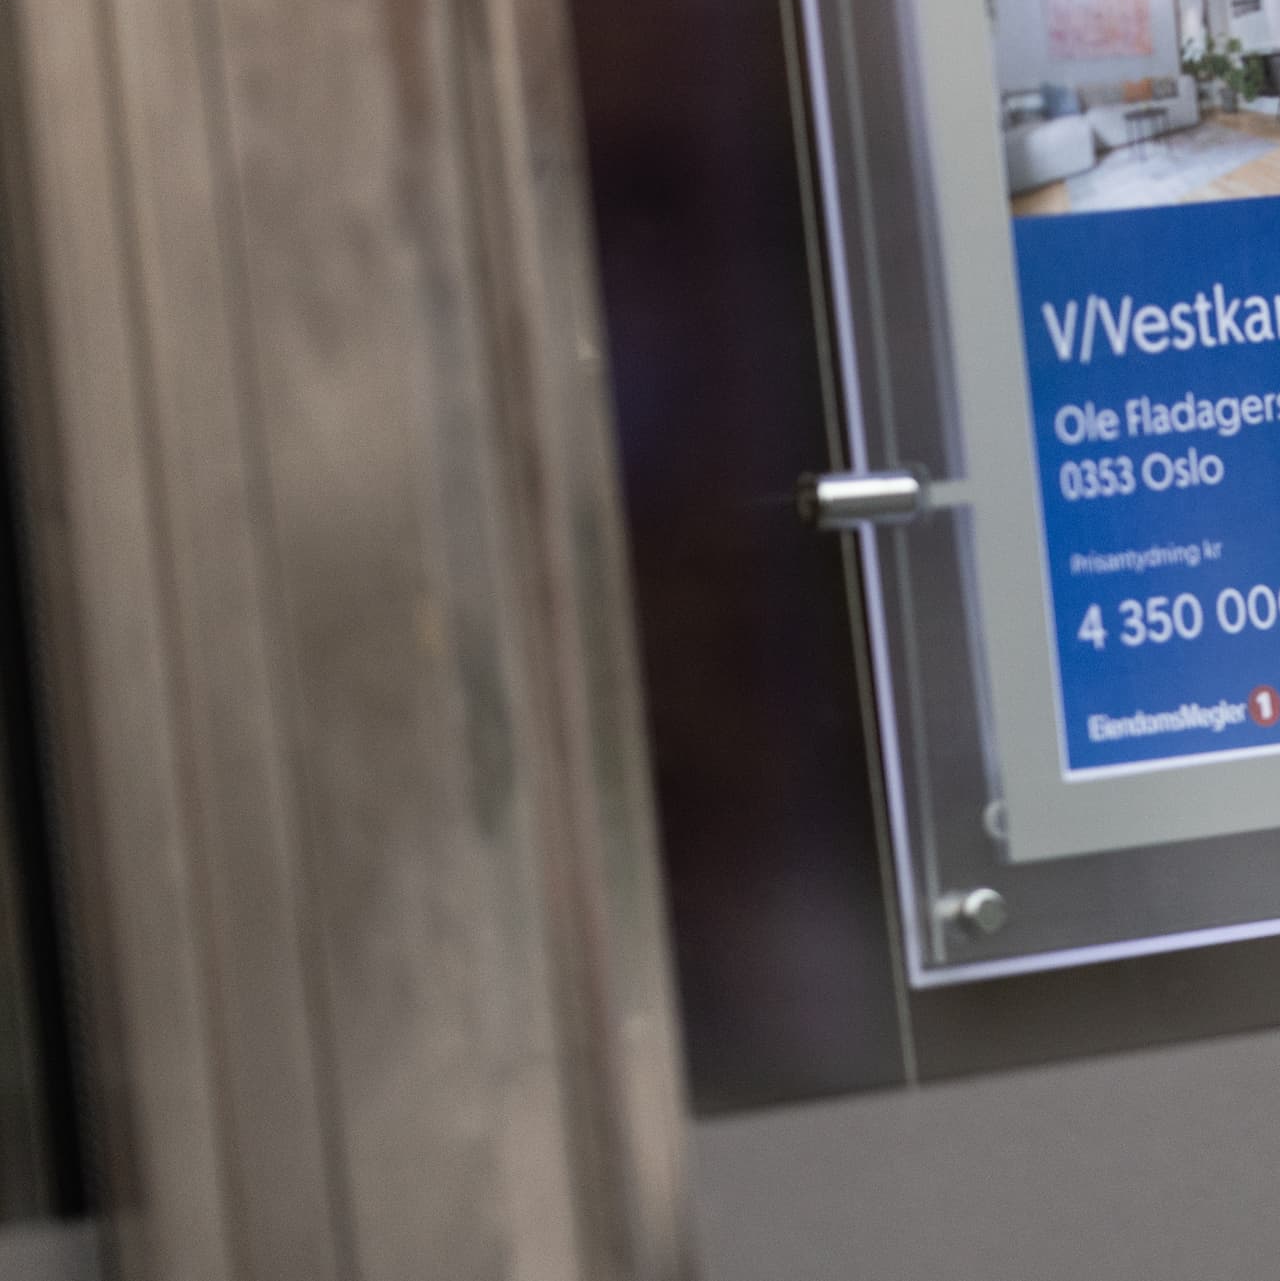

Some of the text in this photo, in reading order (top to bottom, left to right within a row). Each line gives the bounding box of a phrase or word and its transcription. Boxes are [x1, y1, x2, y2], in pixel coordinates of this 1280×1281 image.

[1054, 401, 1120, 445] Ole
[1060, 446, 1224, 501] 0353 Oslo
[1070, 539, 1223, 575] Prisantydning kr
[1077, 603, 1107, 651] 4
[1118, 592, 1203, 647] 350
